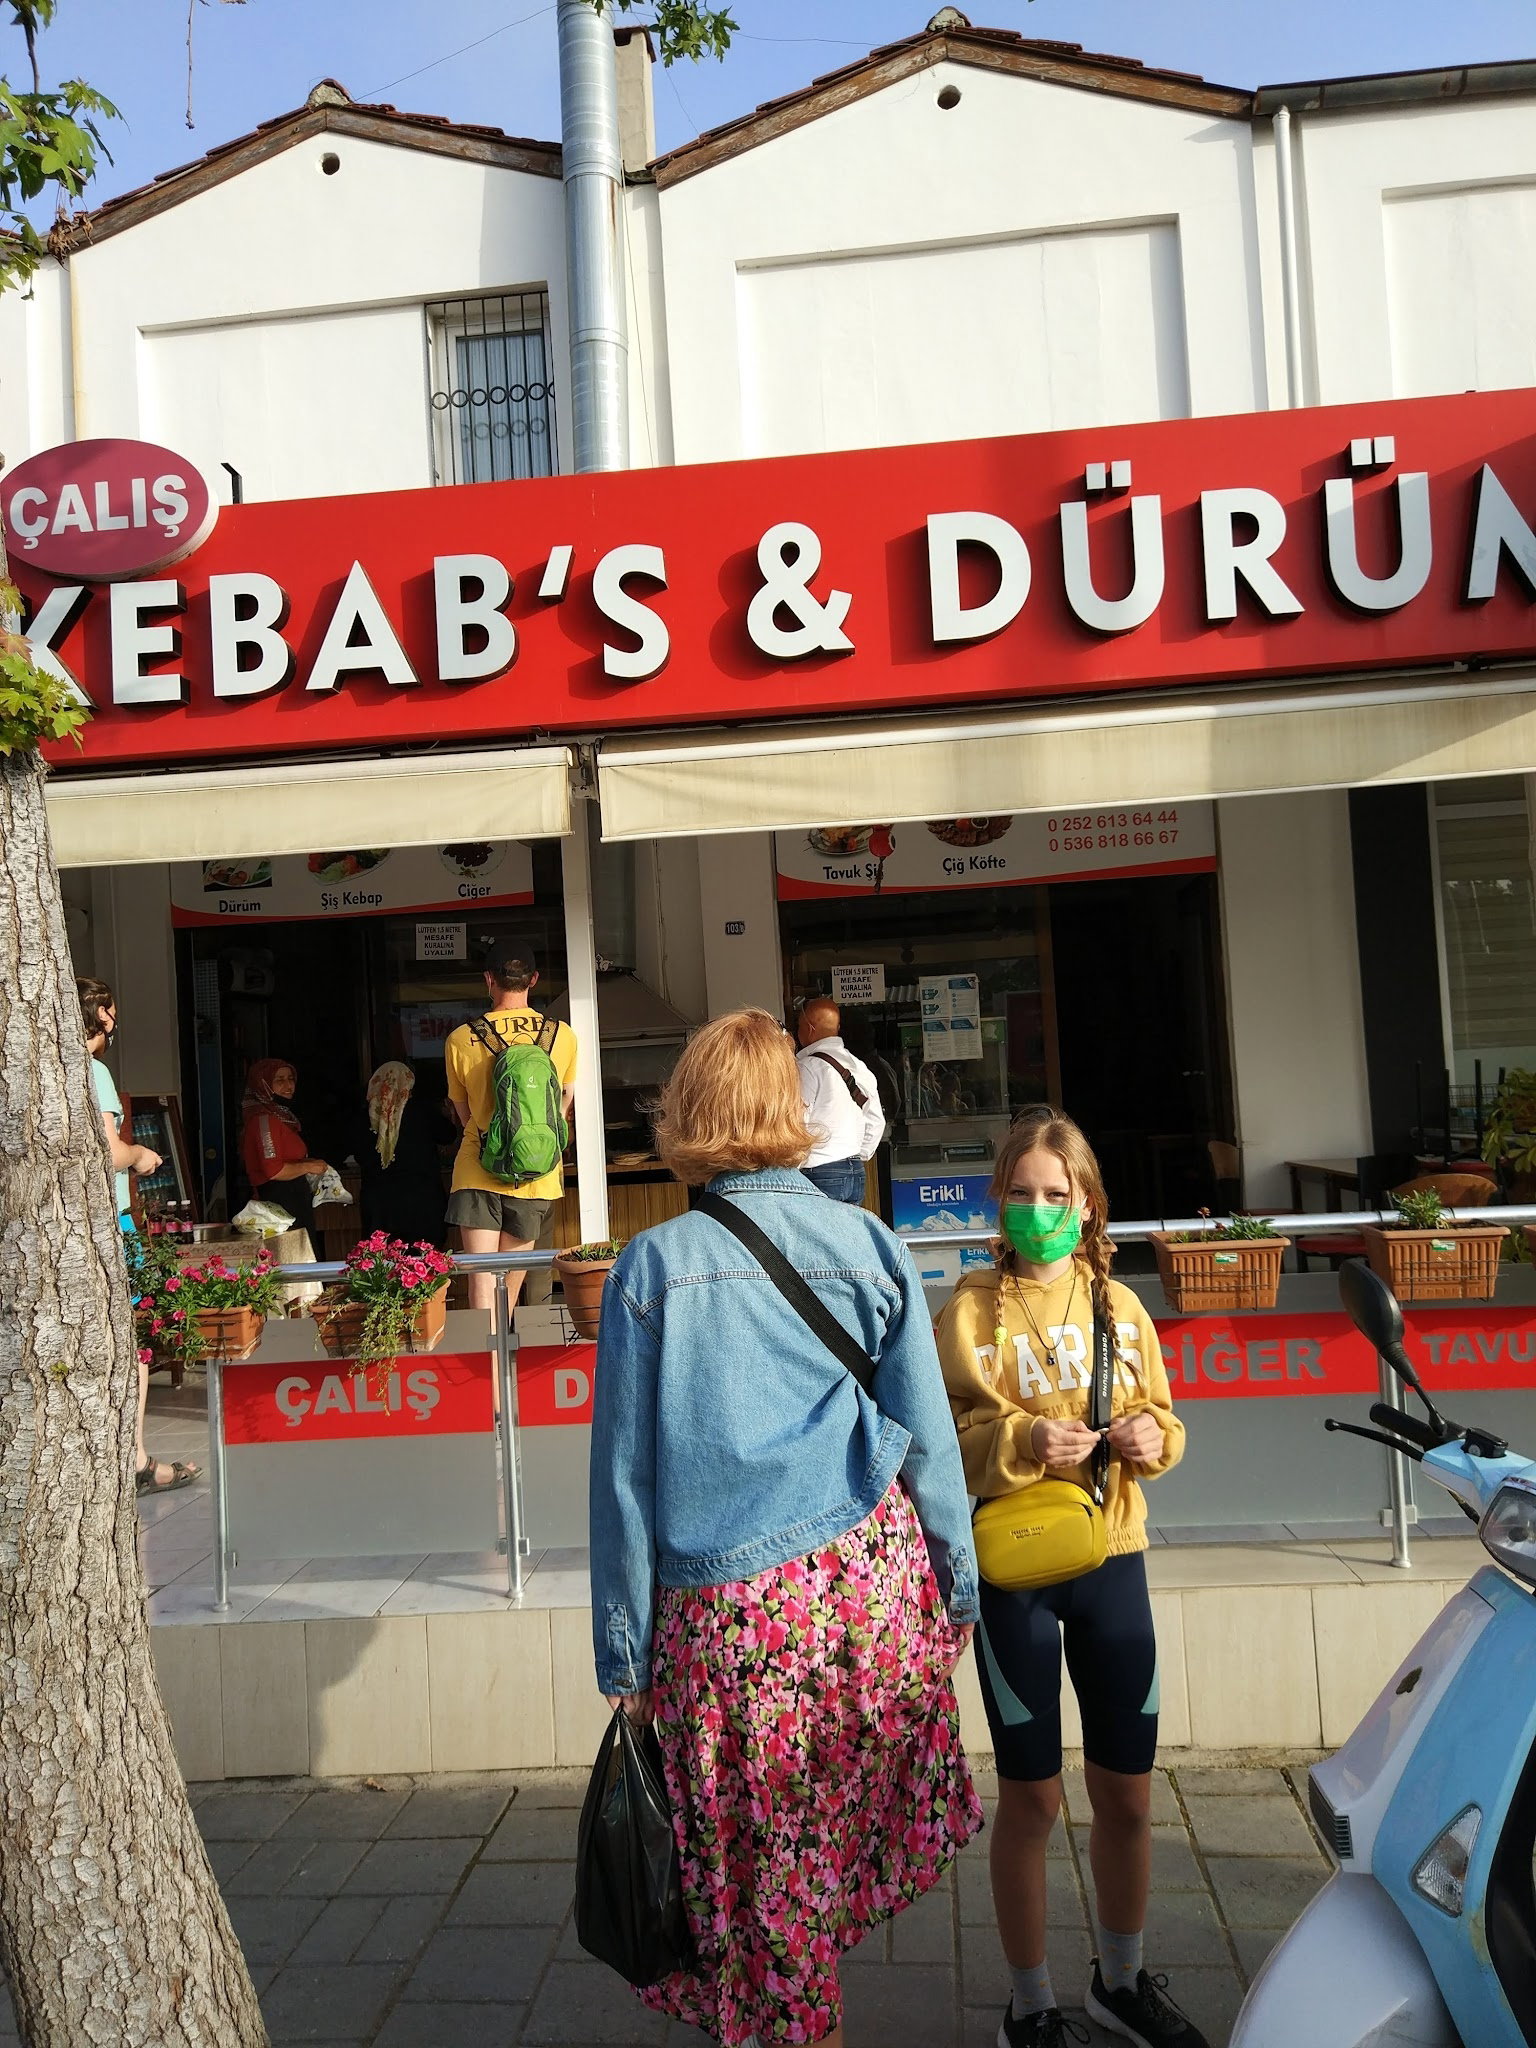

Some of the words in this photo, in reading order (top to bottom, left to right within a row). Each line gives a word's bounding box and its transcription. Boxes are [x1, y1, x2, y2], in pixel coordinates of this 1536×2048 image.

[9, 474, 189, 550] ÇALIŞ
[746, 521, 854, 659] &
[1048, 819, 1058, 832] 0
[1062, 816, 1092, 831] 252
[1097, 813, 1128, 829] 613
[1132, 811, 1153, 826] 64
[1157, 809, 1178, 824] 44
[1049, 838, 1059, 852] 0
[1064, 836, 1093, 851] 536
[1098, 833, 1129, 848] 818
[1134, 831, 1154, 846] 66
[1159, 830, 1179, 844] 67
[822, 864, 862, 880] Tavuk
[942, 857, 965, 876] Çiğ
[969, 854, 1006, 870] Köfte
[320, 893, 339, 910] Şiş
[342, 890, 383, 907] Kebap
[457, 883, 492, 900] Ciğer
[218, 898, 261, 914] Dürüm
[840, 976, 872, 984] MESAFE
[840, 983, 873, 992] KURALINA
[841, 991, 872, 999] UYALIM
[919, 1184, 965, 1202] Erikli
[275, 1368, 441, 1428] ÇALIŞ
